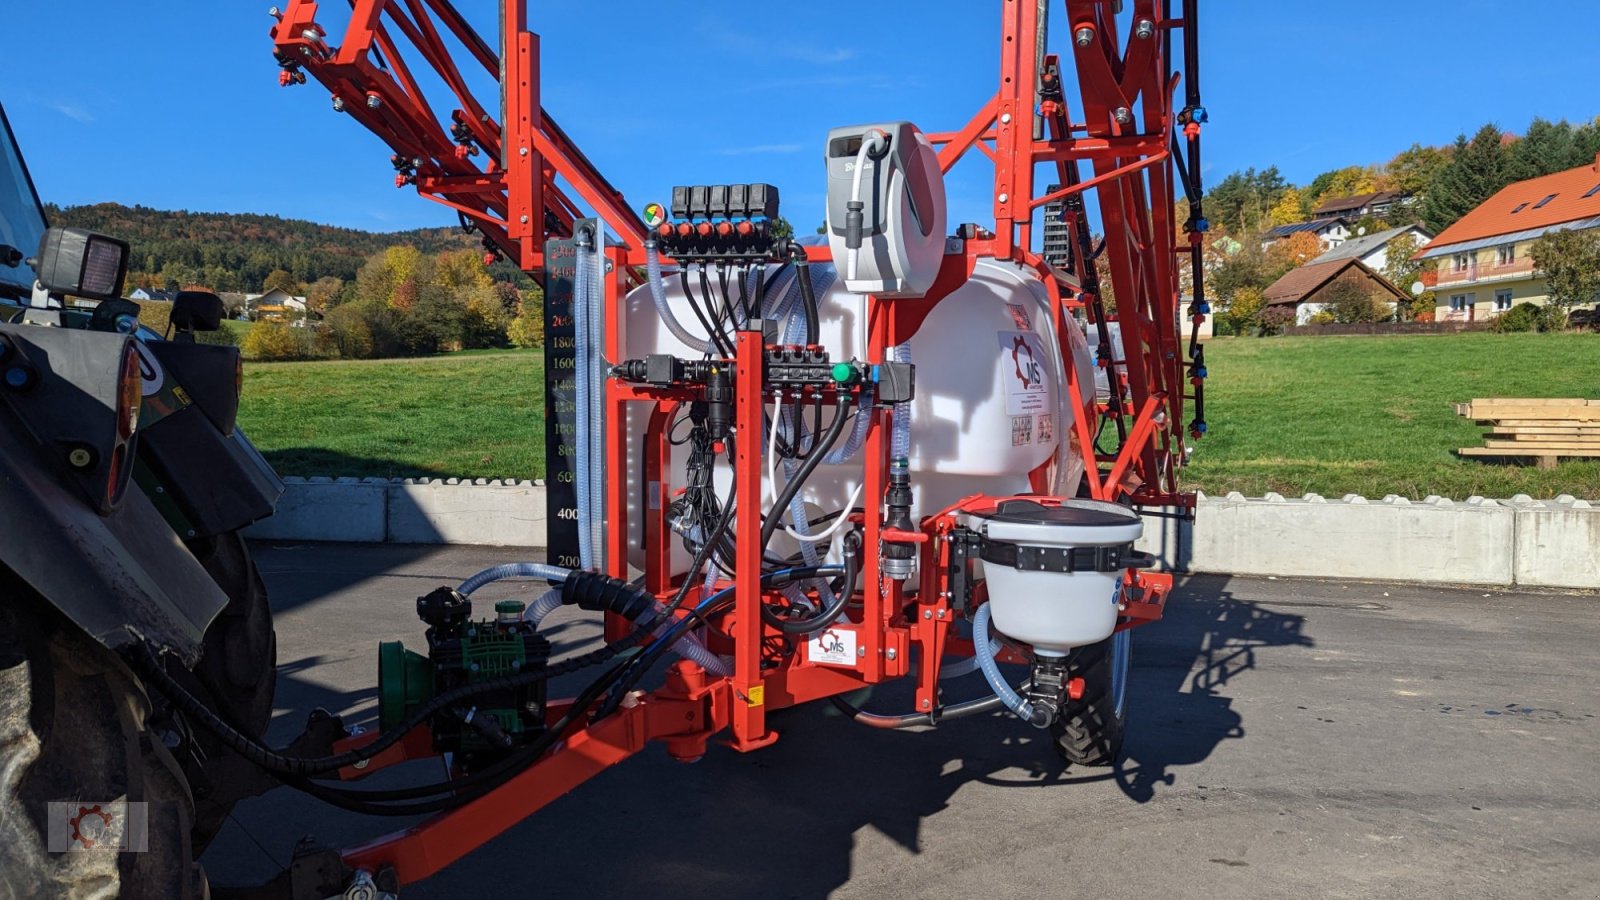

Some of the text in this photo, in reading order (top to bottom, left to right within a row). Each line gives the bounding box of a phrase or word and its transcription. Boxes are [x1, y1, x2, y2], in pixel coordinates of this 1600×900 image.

[554, 357, 577, 369] 1600
[1026, 362, 1041, 384] MS
[557, 507, 579, 520] 400
[558, 555, 580, 567] 200
[830, 642, 844, 653] MS
